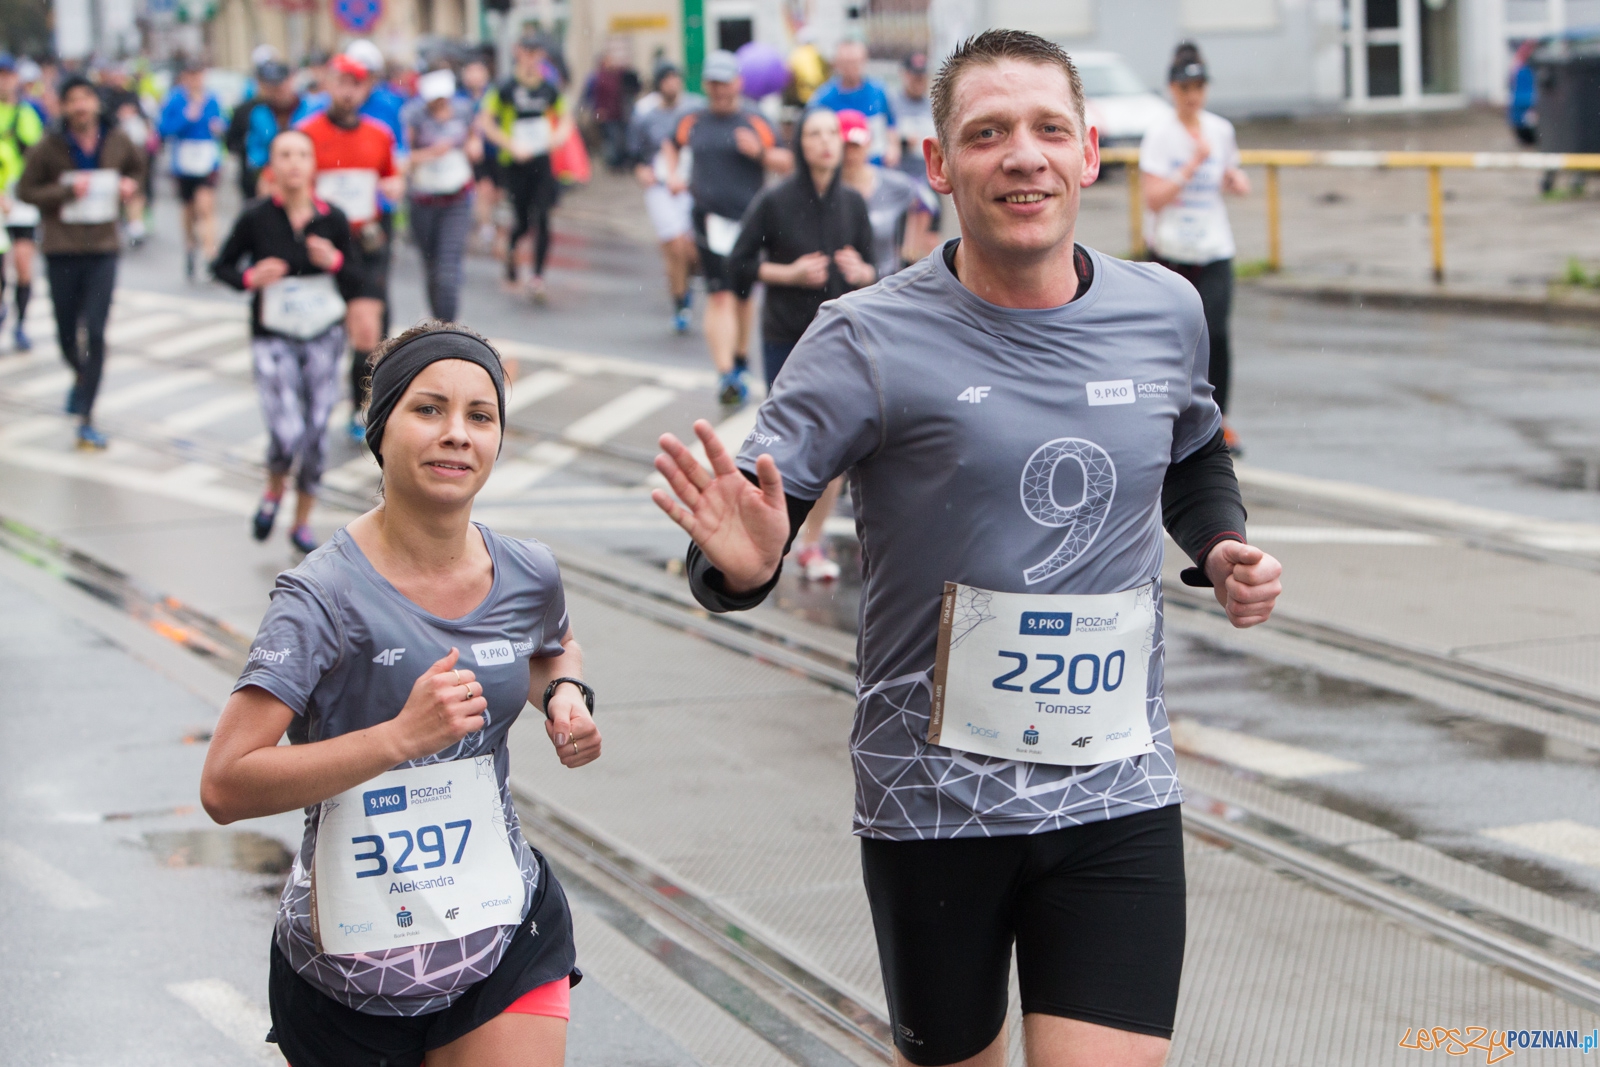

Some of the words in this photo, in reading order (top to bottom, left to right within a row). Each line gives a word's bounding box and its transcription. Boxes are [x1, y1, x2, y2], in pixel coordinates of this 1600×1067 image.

[957, 386, 992, 403] 4F
[1020, 437, 1117, 585] 9
[372, 648, 406, 666] 4F
[992, 649, 1125, 695] 2200
[1035, 701, 1091, 714] Tomasz
[1071, 736, 1093, 748] 4F
[351, 819, 472, 879] 3297
[388, 875, 455, 894] Aleksandra
[445, 907, 459, 920] 4F
